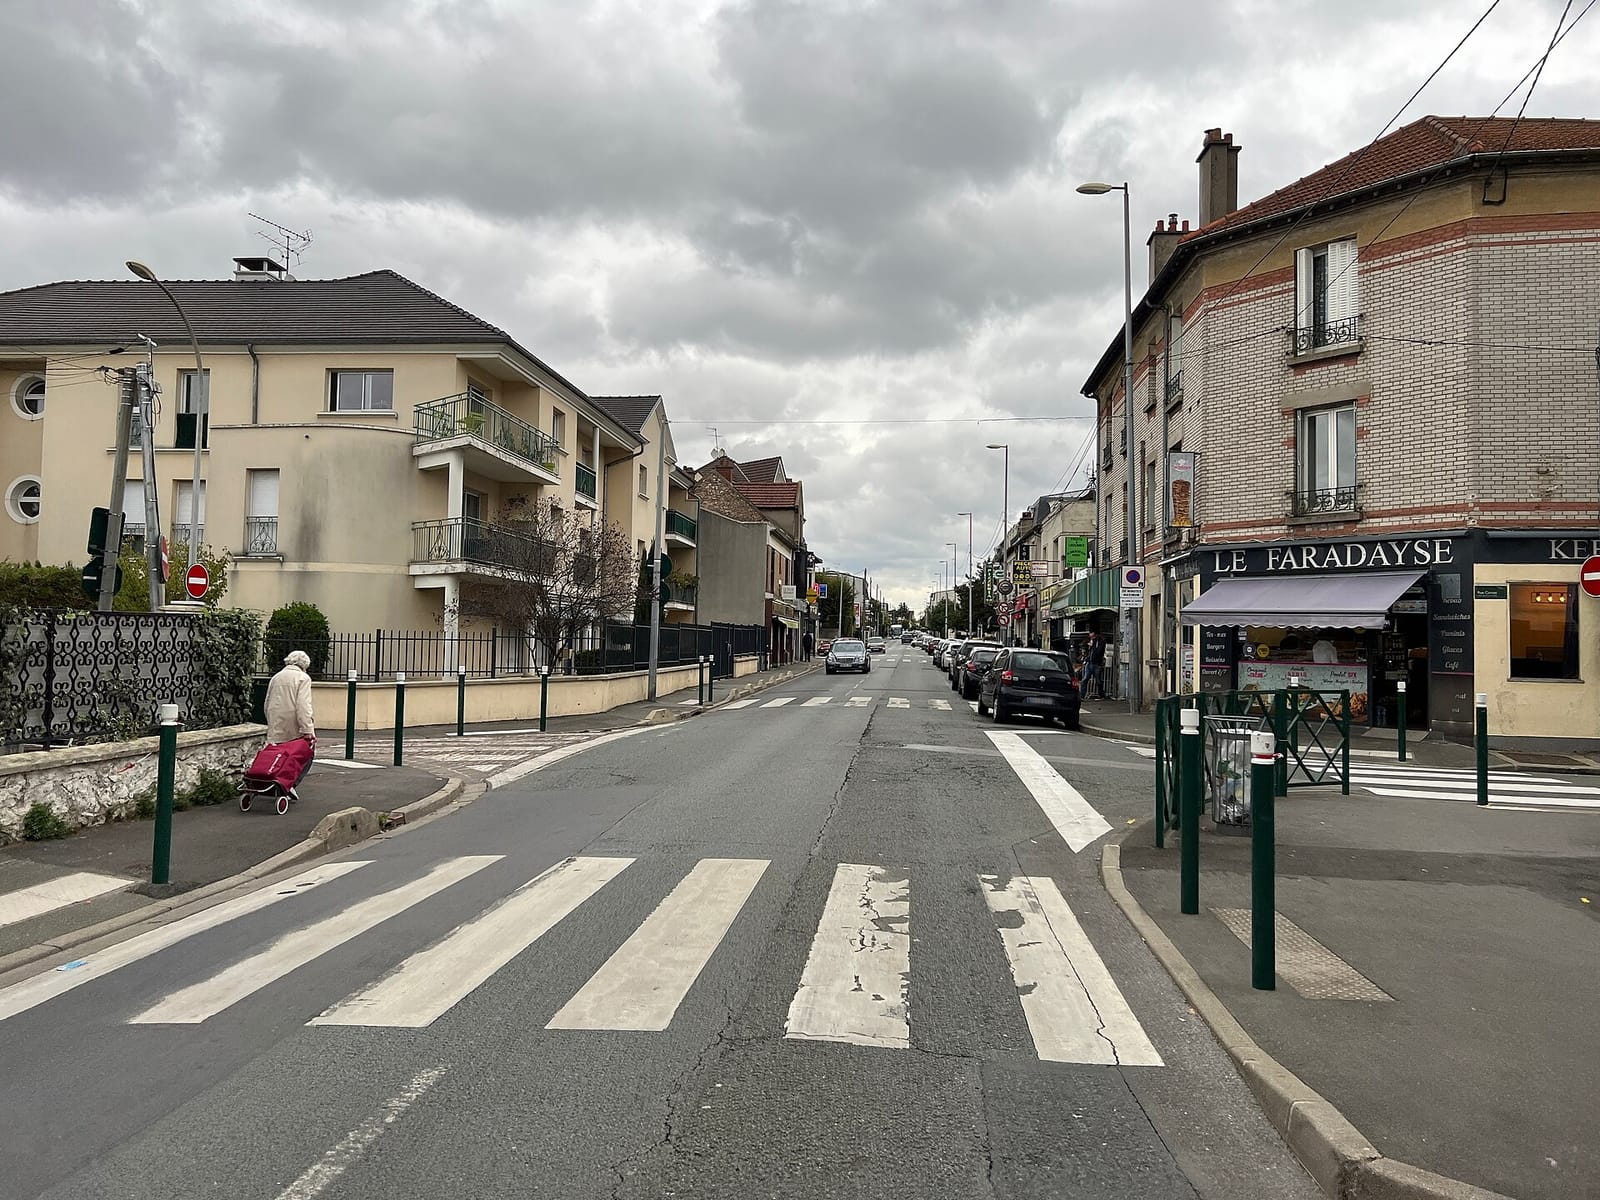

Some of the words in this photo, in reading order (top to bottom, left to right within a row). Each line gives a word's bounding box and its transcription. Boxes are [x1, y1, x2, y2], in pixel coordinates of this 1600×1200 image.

[1213, 550, 1248, 573] LE
[1266, 539, 1454, 571] FARADAYSE
[1444, 661, 1460, 671] Café
